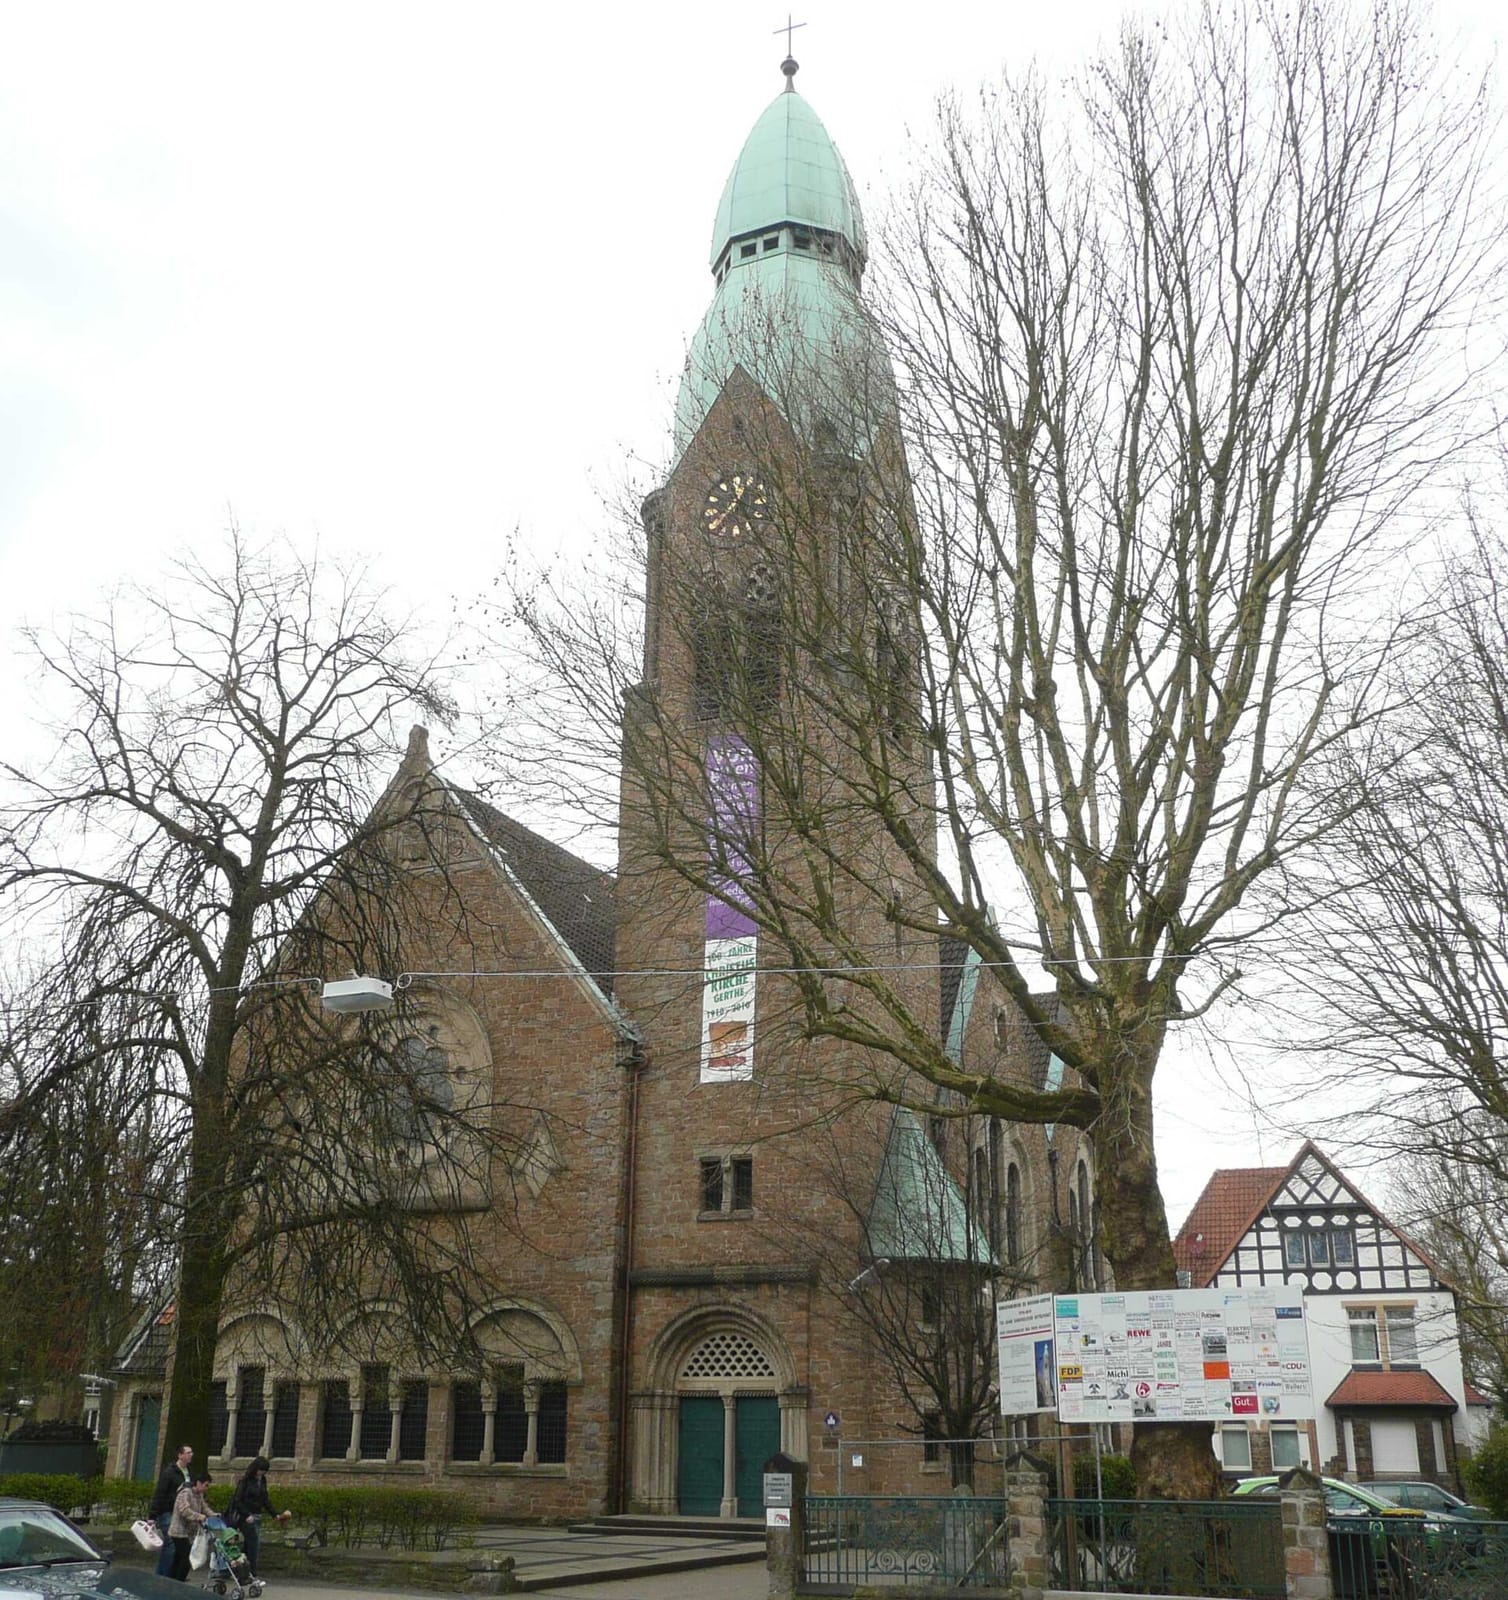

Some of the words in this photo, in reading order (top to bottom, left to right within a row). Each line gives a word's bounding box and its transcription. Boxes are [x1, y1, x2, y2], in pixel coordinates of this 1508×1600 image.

[728, 944, 753, 957] JAHRE
[711, 974, 749, 993] KIRCHE
[713, 987, 745, 1003] GERTHE
[1127, 1329, 1151, 1337] REWE
[1286, 1362, 1303, 1370] CDU
[1061, 1367, 1080, 1376] FDP
[1106, 1370, 1129, 1378] Michl
